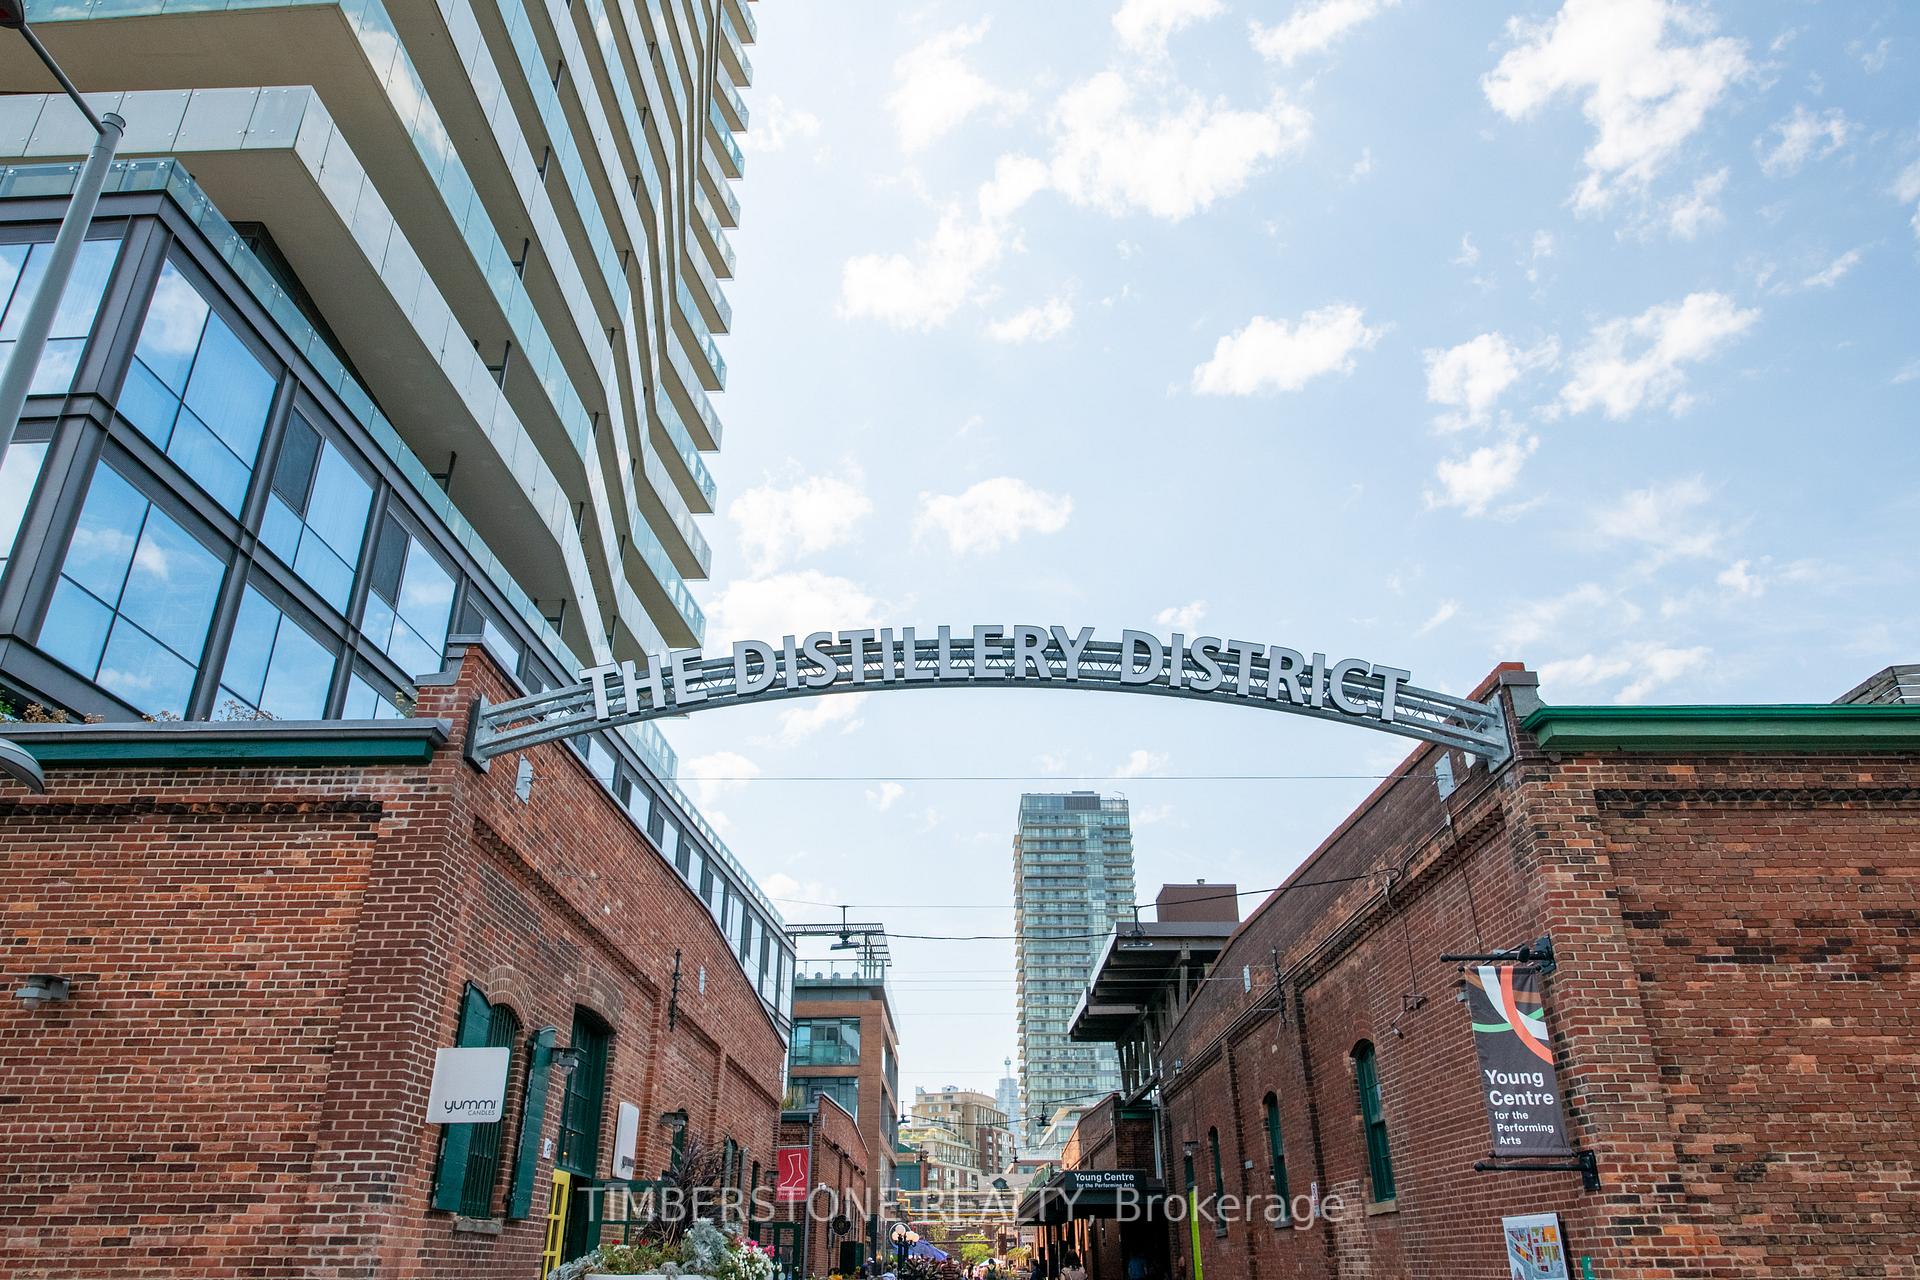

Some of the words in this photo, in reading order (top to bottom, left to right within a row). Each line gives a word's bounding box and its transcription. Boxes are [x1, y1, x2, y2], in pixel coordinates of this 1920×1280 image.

[579, 648, 707, 721] THE
[733, 624, 1096, 696] DISTILLERY
[1120, 628, 1411, 723] DISTRICT
[1484, 1069, 1544, 1087] Young
[1489, 1090, 1554, 1106] Centre
[444, 1100, 496, 1114] yummi
[1494, 1111, 1509, 1119] for
[1512, 1111, 1529, 1119] the
[1496, 1123, 1554, 1133] Performing
[1499, 1136, 1522, 1145] Arts
[1074, 1172, 1102, 1182] Young
[1104, 1172, 1135, 1181] Centre
